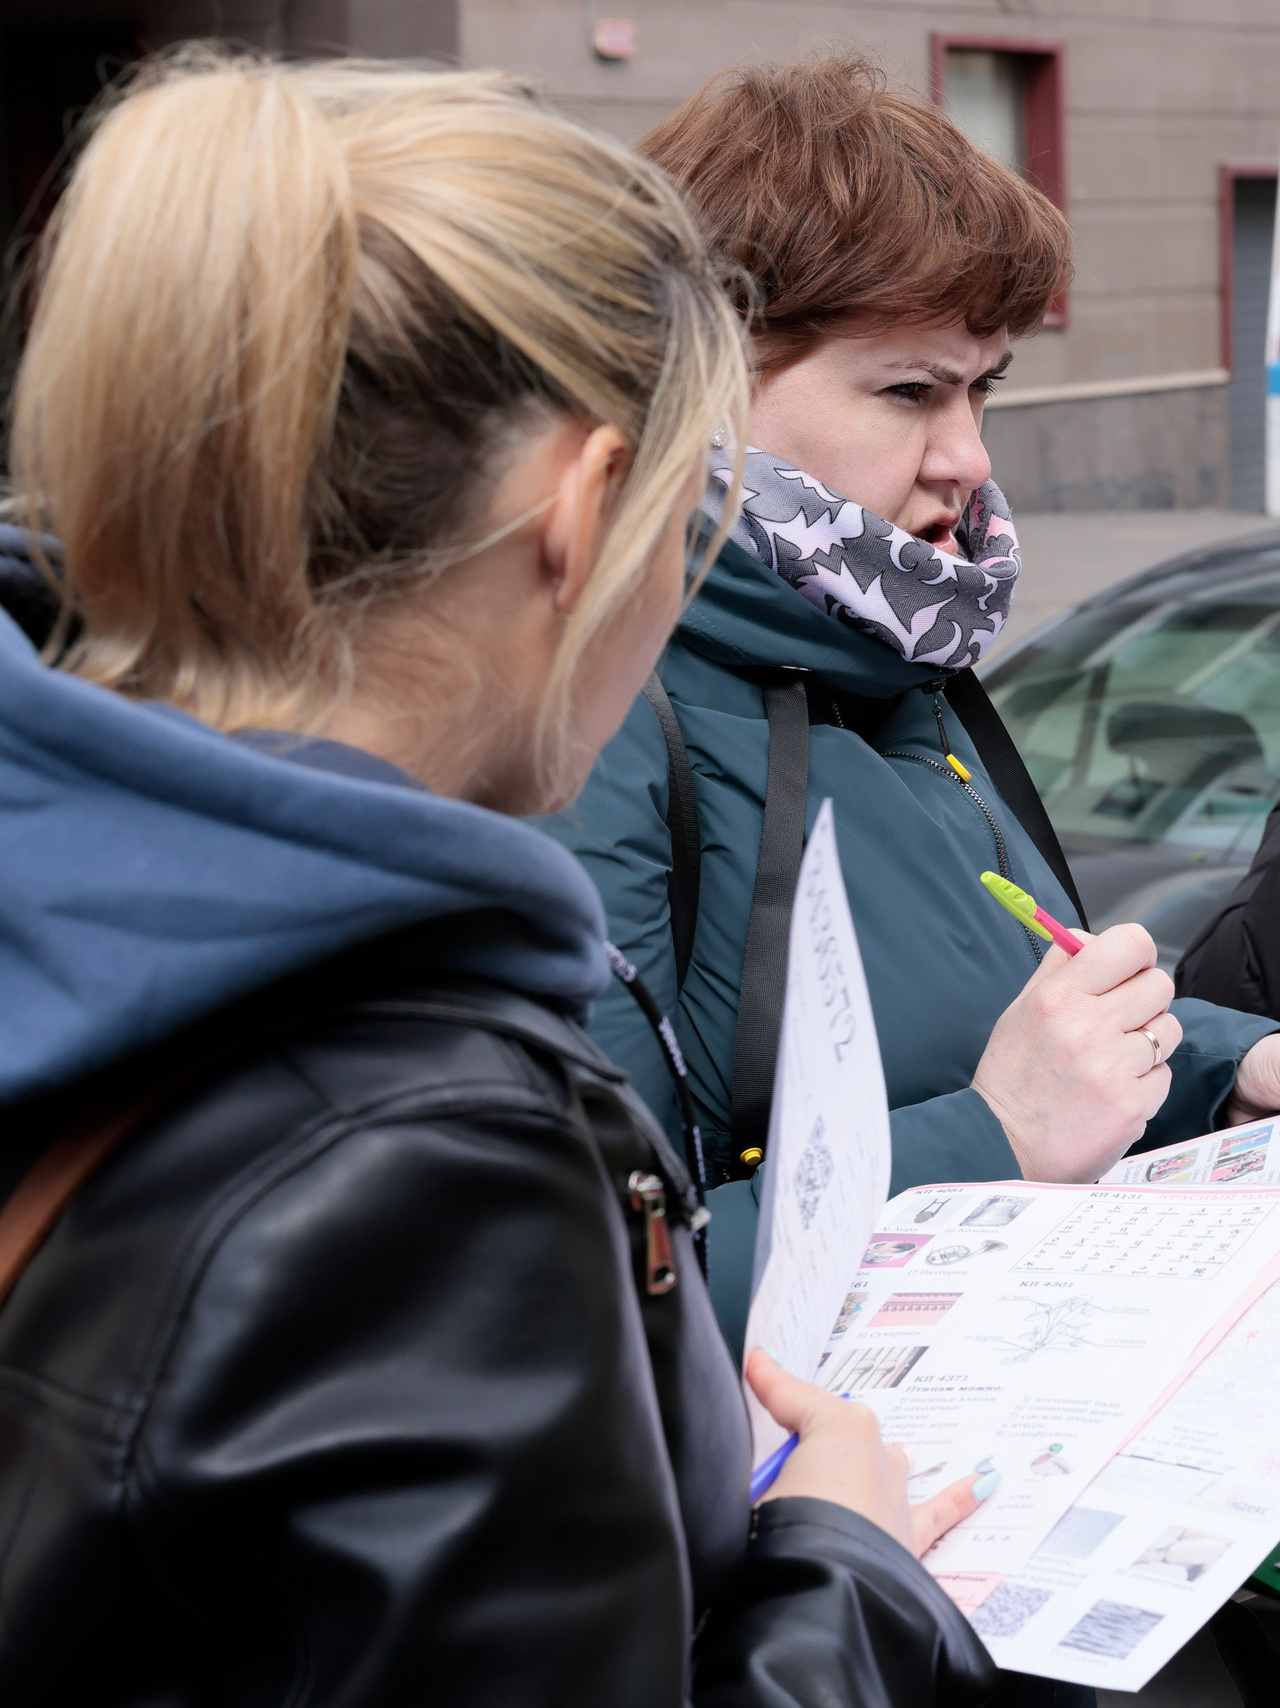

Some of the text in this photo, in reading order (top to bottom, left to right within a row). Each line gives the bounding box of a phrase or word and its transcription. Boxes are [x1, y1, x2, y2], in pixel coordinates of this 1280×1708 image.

[1112, 1192, 1143, 1200] 4131
[1158, 1192, 1238, 1201] КРАСНЫЙ
[1042, 1281, 1075, 1289] 4301
[938, 1374, 969, 1382] 4371
